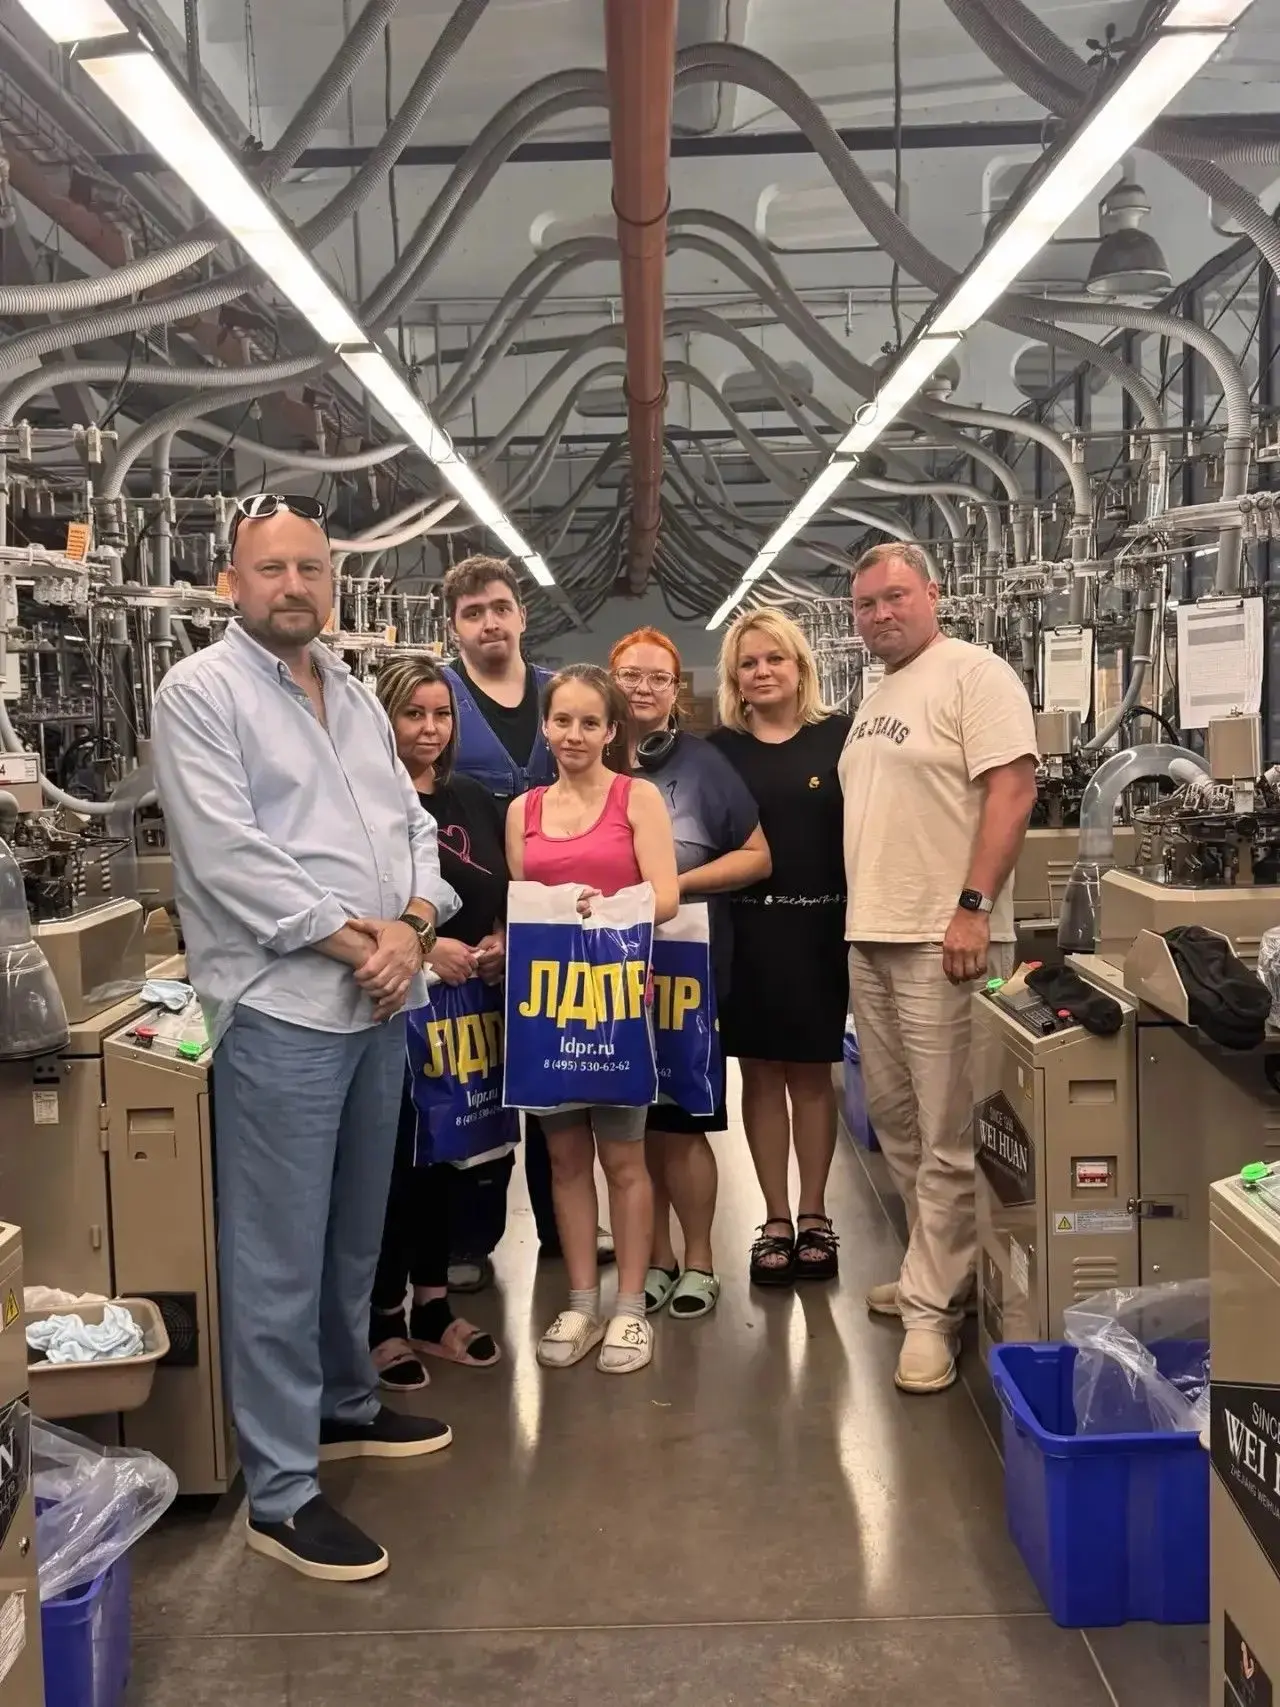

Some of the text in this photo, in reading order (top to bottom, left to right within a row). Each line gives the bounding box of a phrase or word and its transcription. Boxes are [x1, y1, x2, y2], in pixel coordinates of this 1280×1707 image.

[867, 716, 909, 745] JEANS
[560, 1036, 615, 1057] ldpr.ru
[543, 1059, 630, 1072] 8 (495) 530-62-62
[466, 1087, 498, 1108] ldpr.ru
[979, 1118, 997, 1152] WEI
[998, 1130, 1028, 1174] HUAN
[1224, 1407, 1267, 1482] WEI
